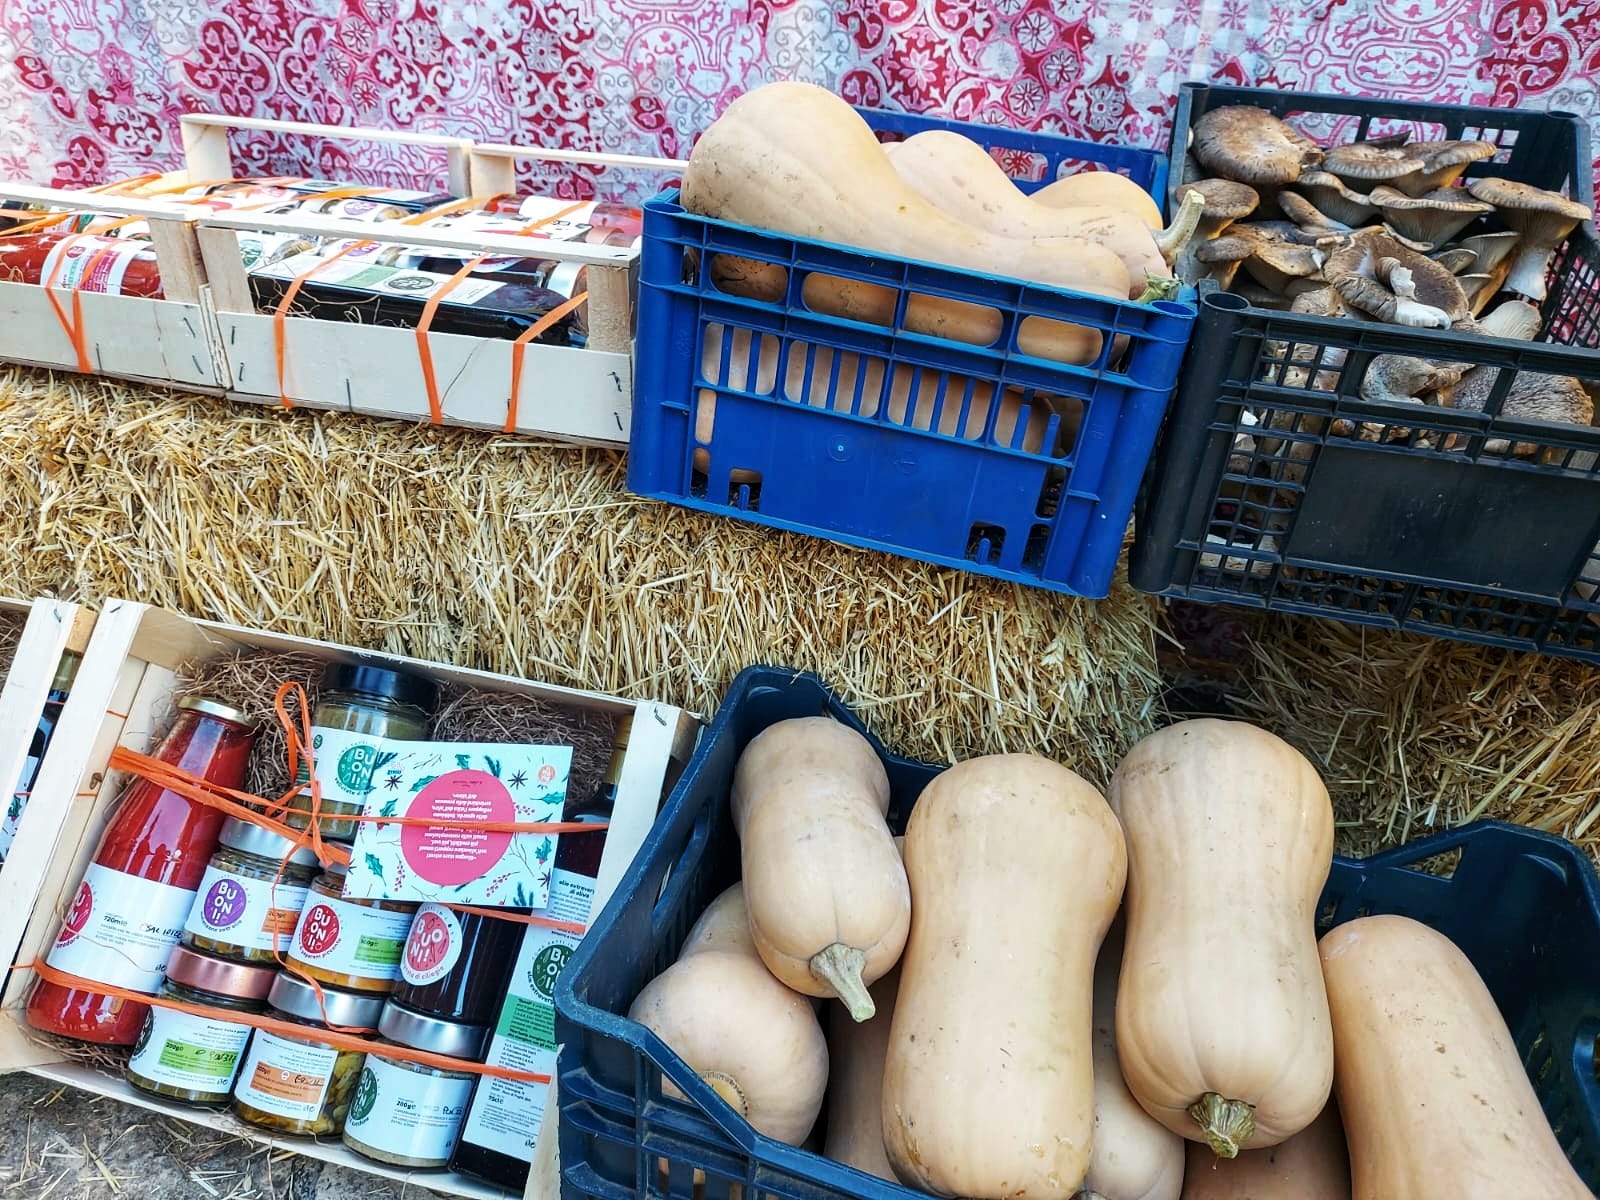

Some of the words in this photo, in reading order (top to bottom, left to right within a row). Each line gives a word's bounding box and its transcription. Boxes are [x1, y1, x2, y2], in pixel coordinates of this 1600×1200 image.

[219, 882, 238, 900] BU
[214, 896, 232, 914] ON
[314, 908, 331, 926] BU
[310, 922, 327, 941] ON
